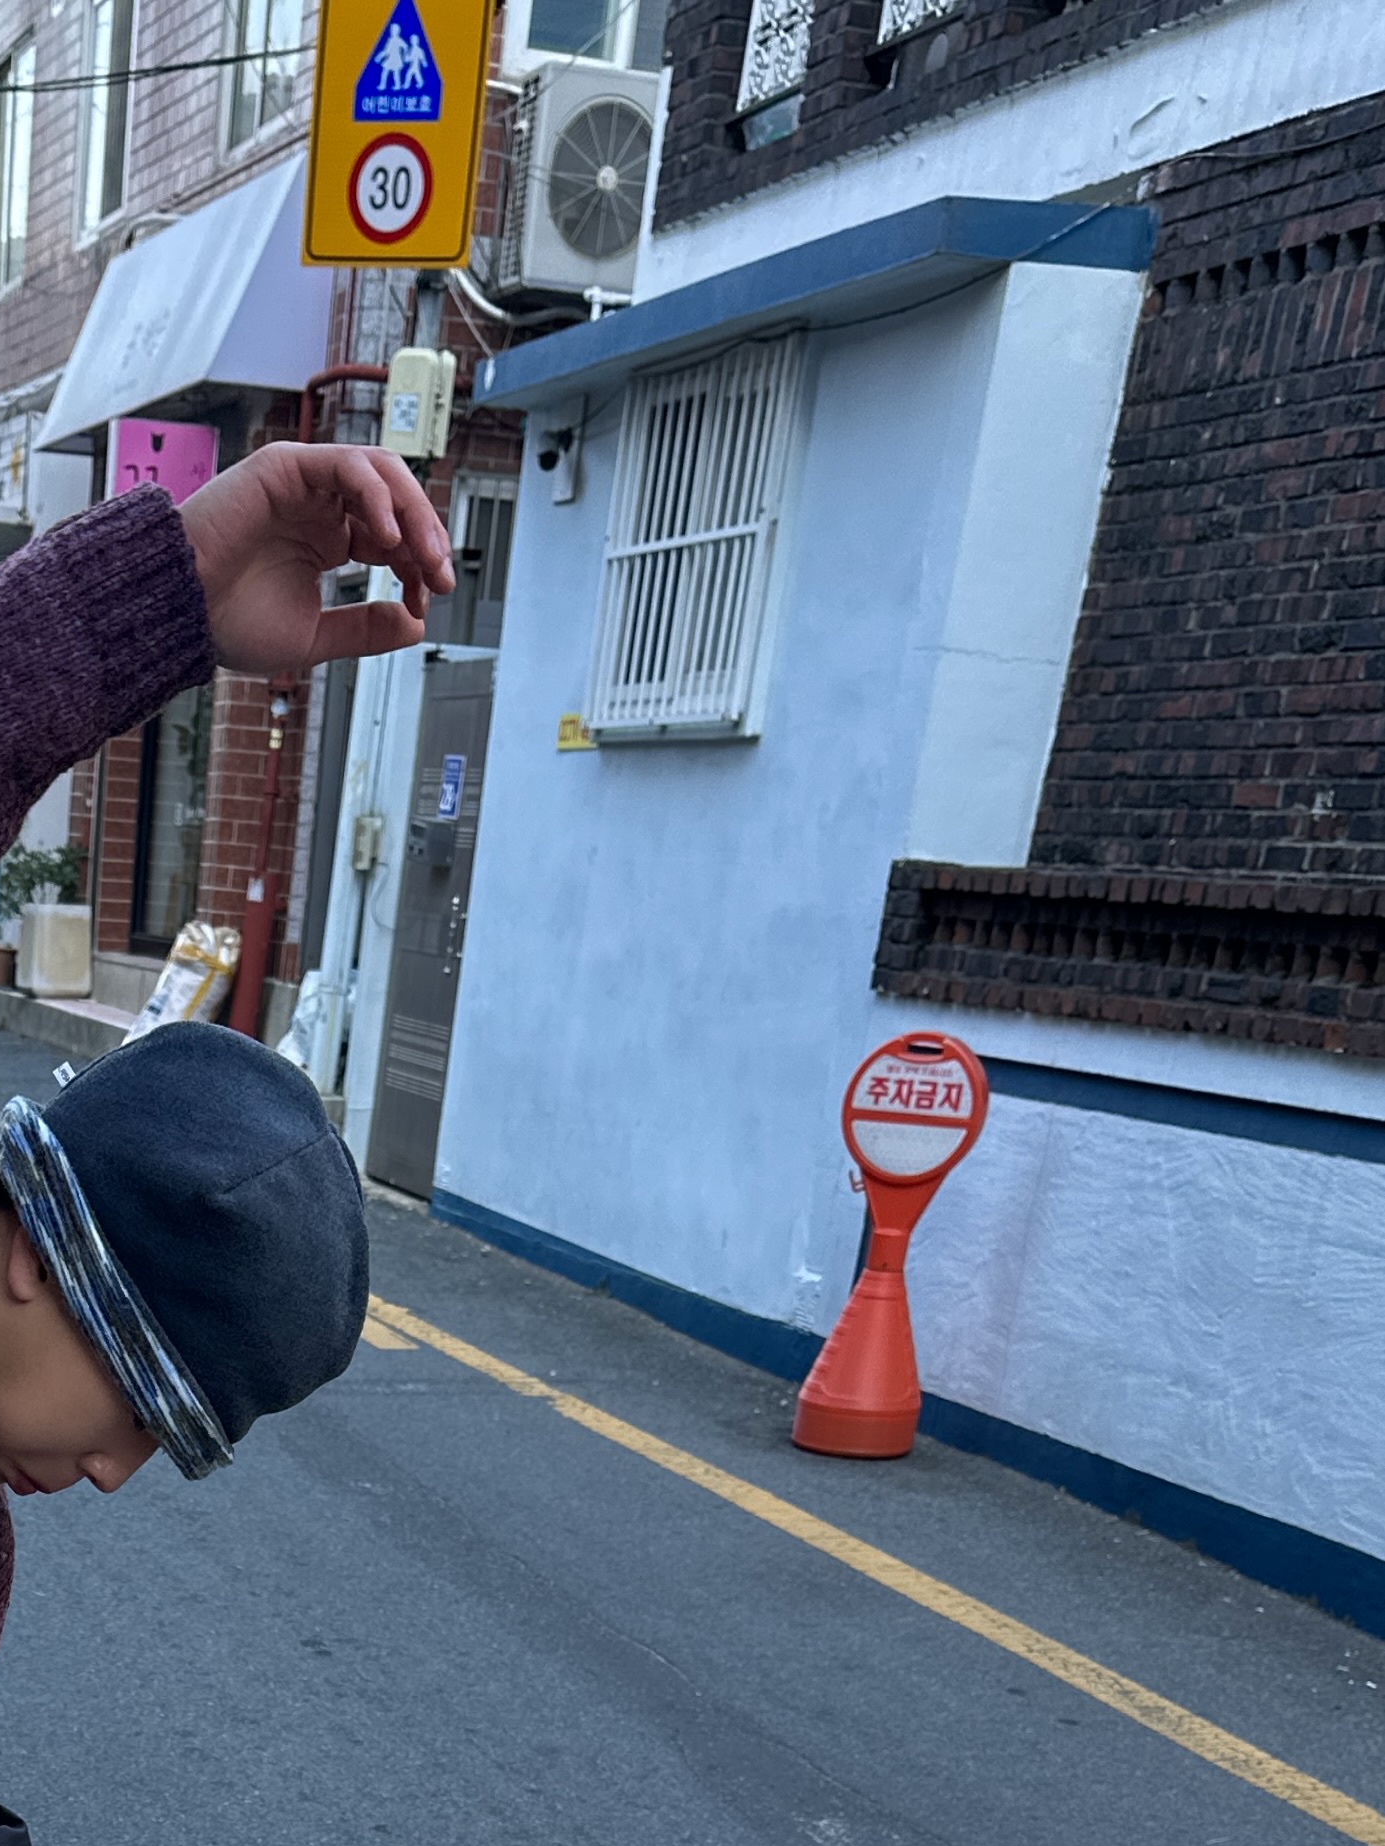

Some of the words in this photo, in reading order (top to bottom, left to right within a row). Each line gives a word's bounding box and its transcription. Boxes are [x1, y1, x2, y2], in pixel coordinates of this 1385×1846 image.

[361, 94, 433, 114] 어린이보호
[369, 166, 412, 210] 30
[868, 1077, 963, 1112] 주차금지
